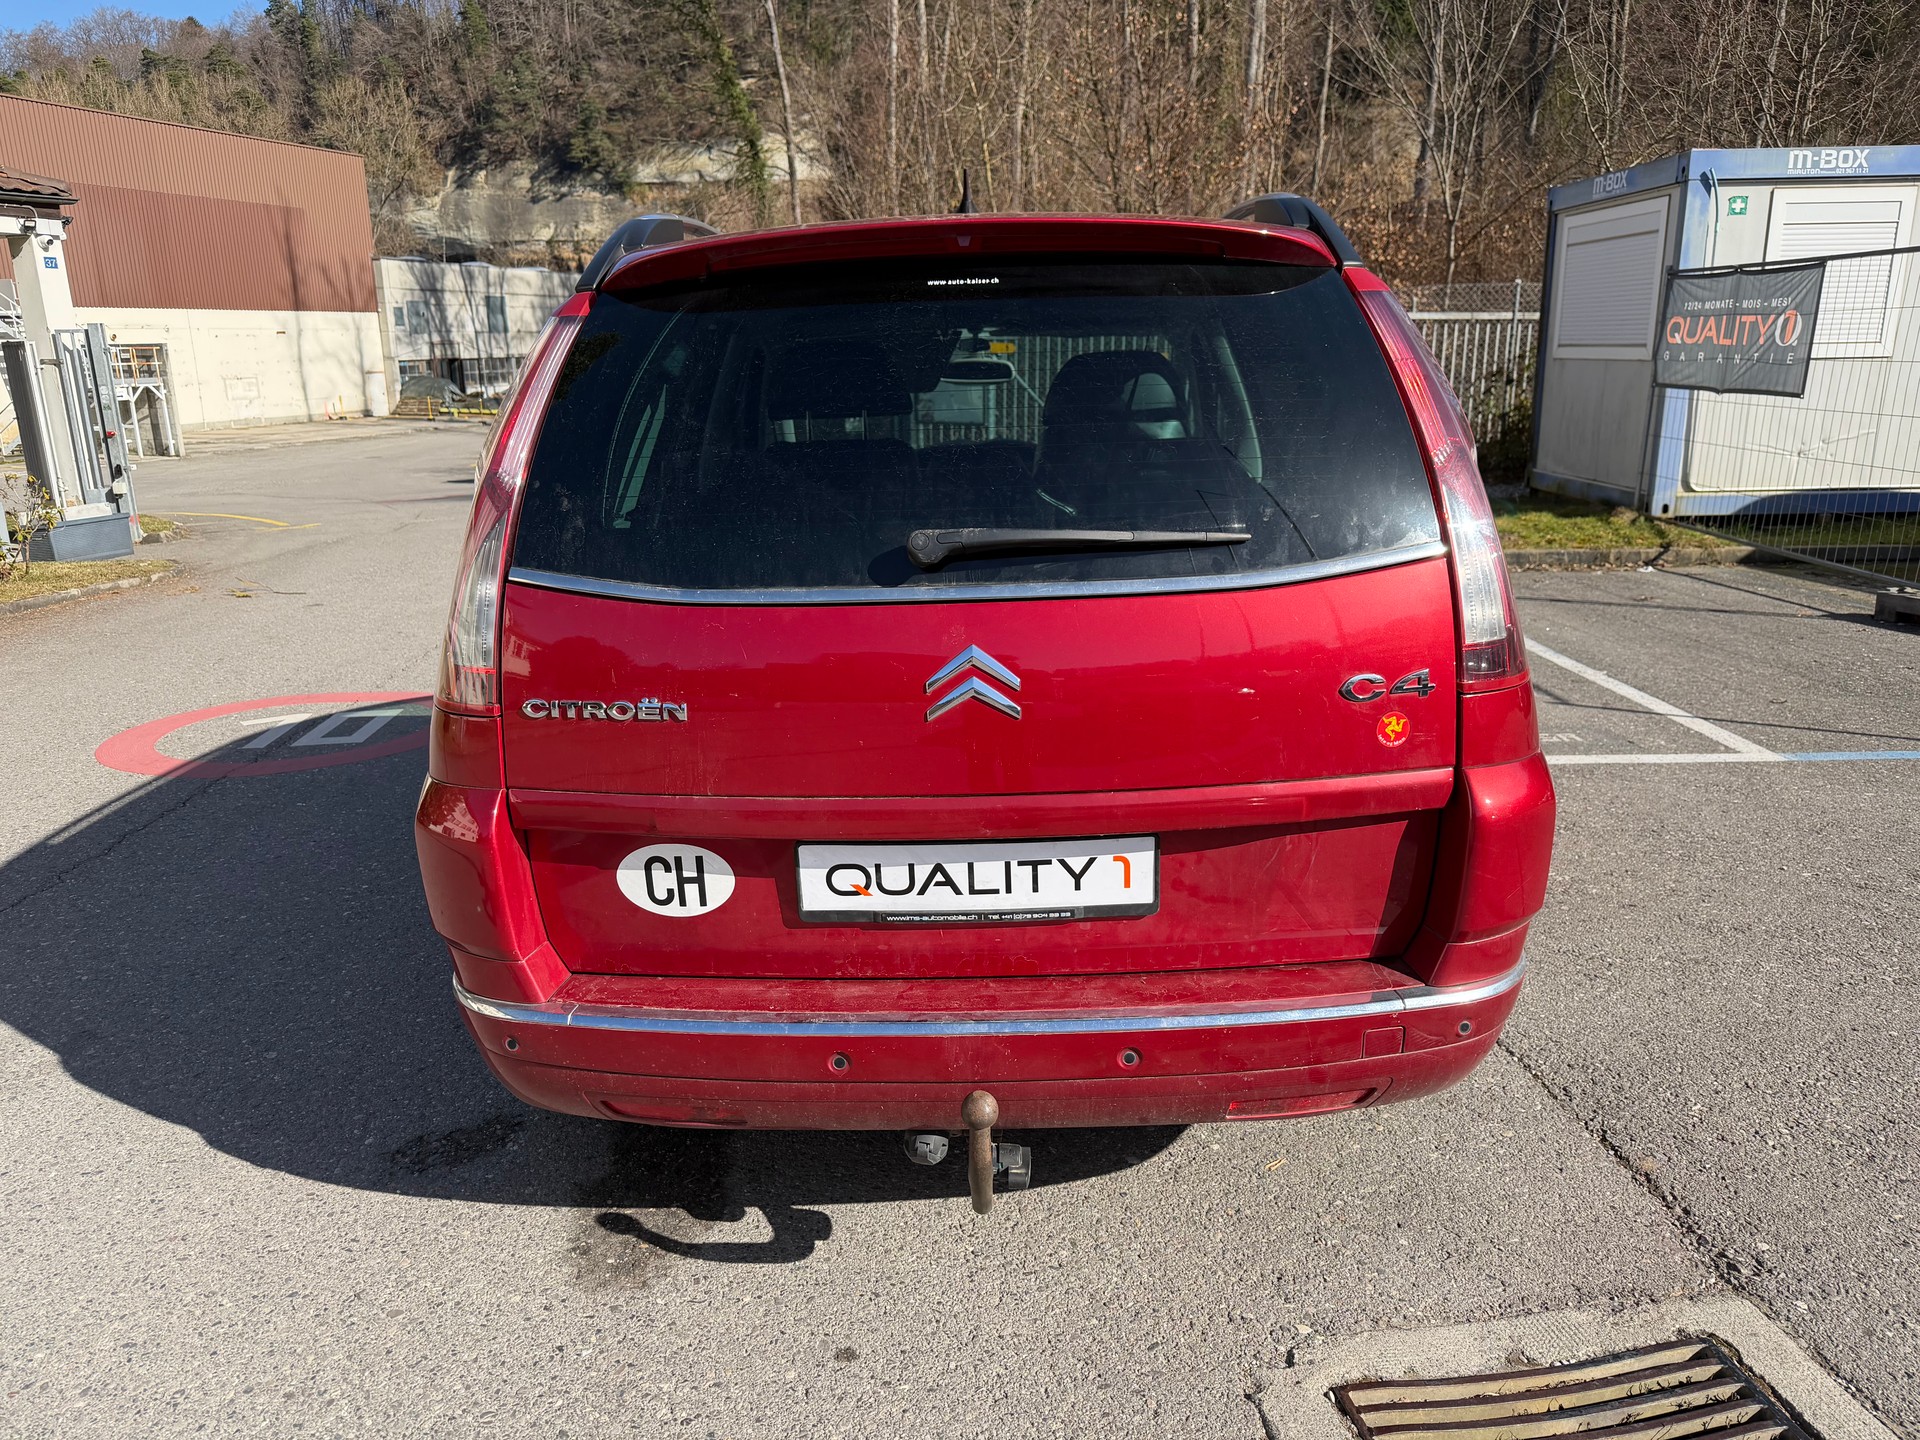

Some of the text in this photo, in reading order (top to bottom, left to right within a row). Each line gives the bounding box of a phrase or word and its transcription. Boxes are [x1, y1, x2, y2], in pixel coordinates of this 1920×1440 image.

[45, 259, 56, 268] 37
[1684, 302, 1702, 310] 12/24
[1704, 299, 1734, 310] MONATE
[1742, 299, 1761, 309] MOIS
[1667, 314, 1776, 346] QUALITY
[1663, 351, 1794, 364] GARANTIE
[1338, 668, 1436, 702] C4
[521, 697, 687, 721] CITROËN
[240, 708, 404, 749] 10
[644, 855, 707, 907] CH
[825, 856, 1130, 897] QUALITY 1
